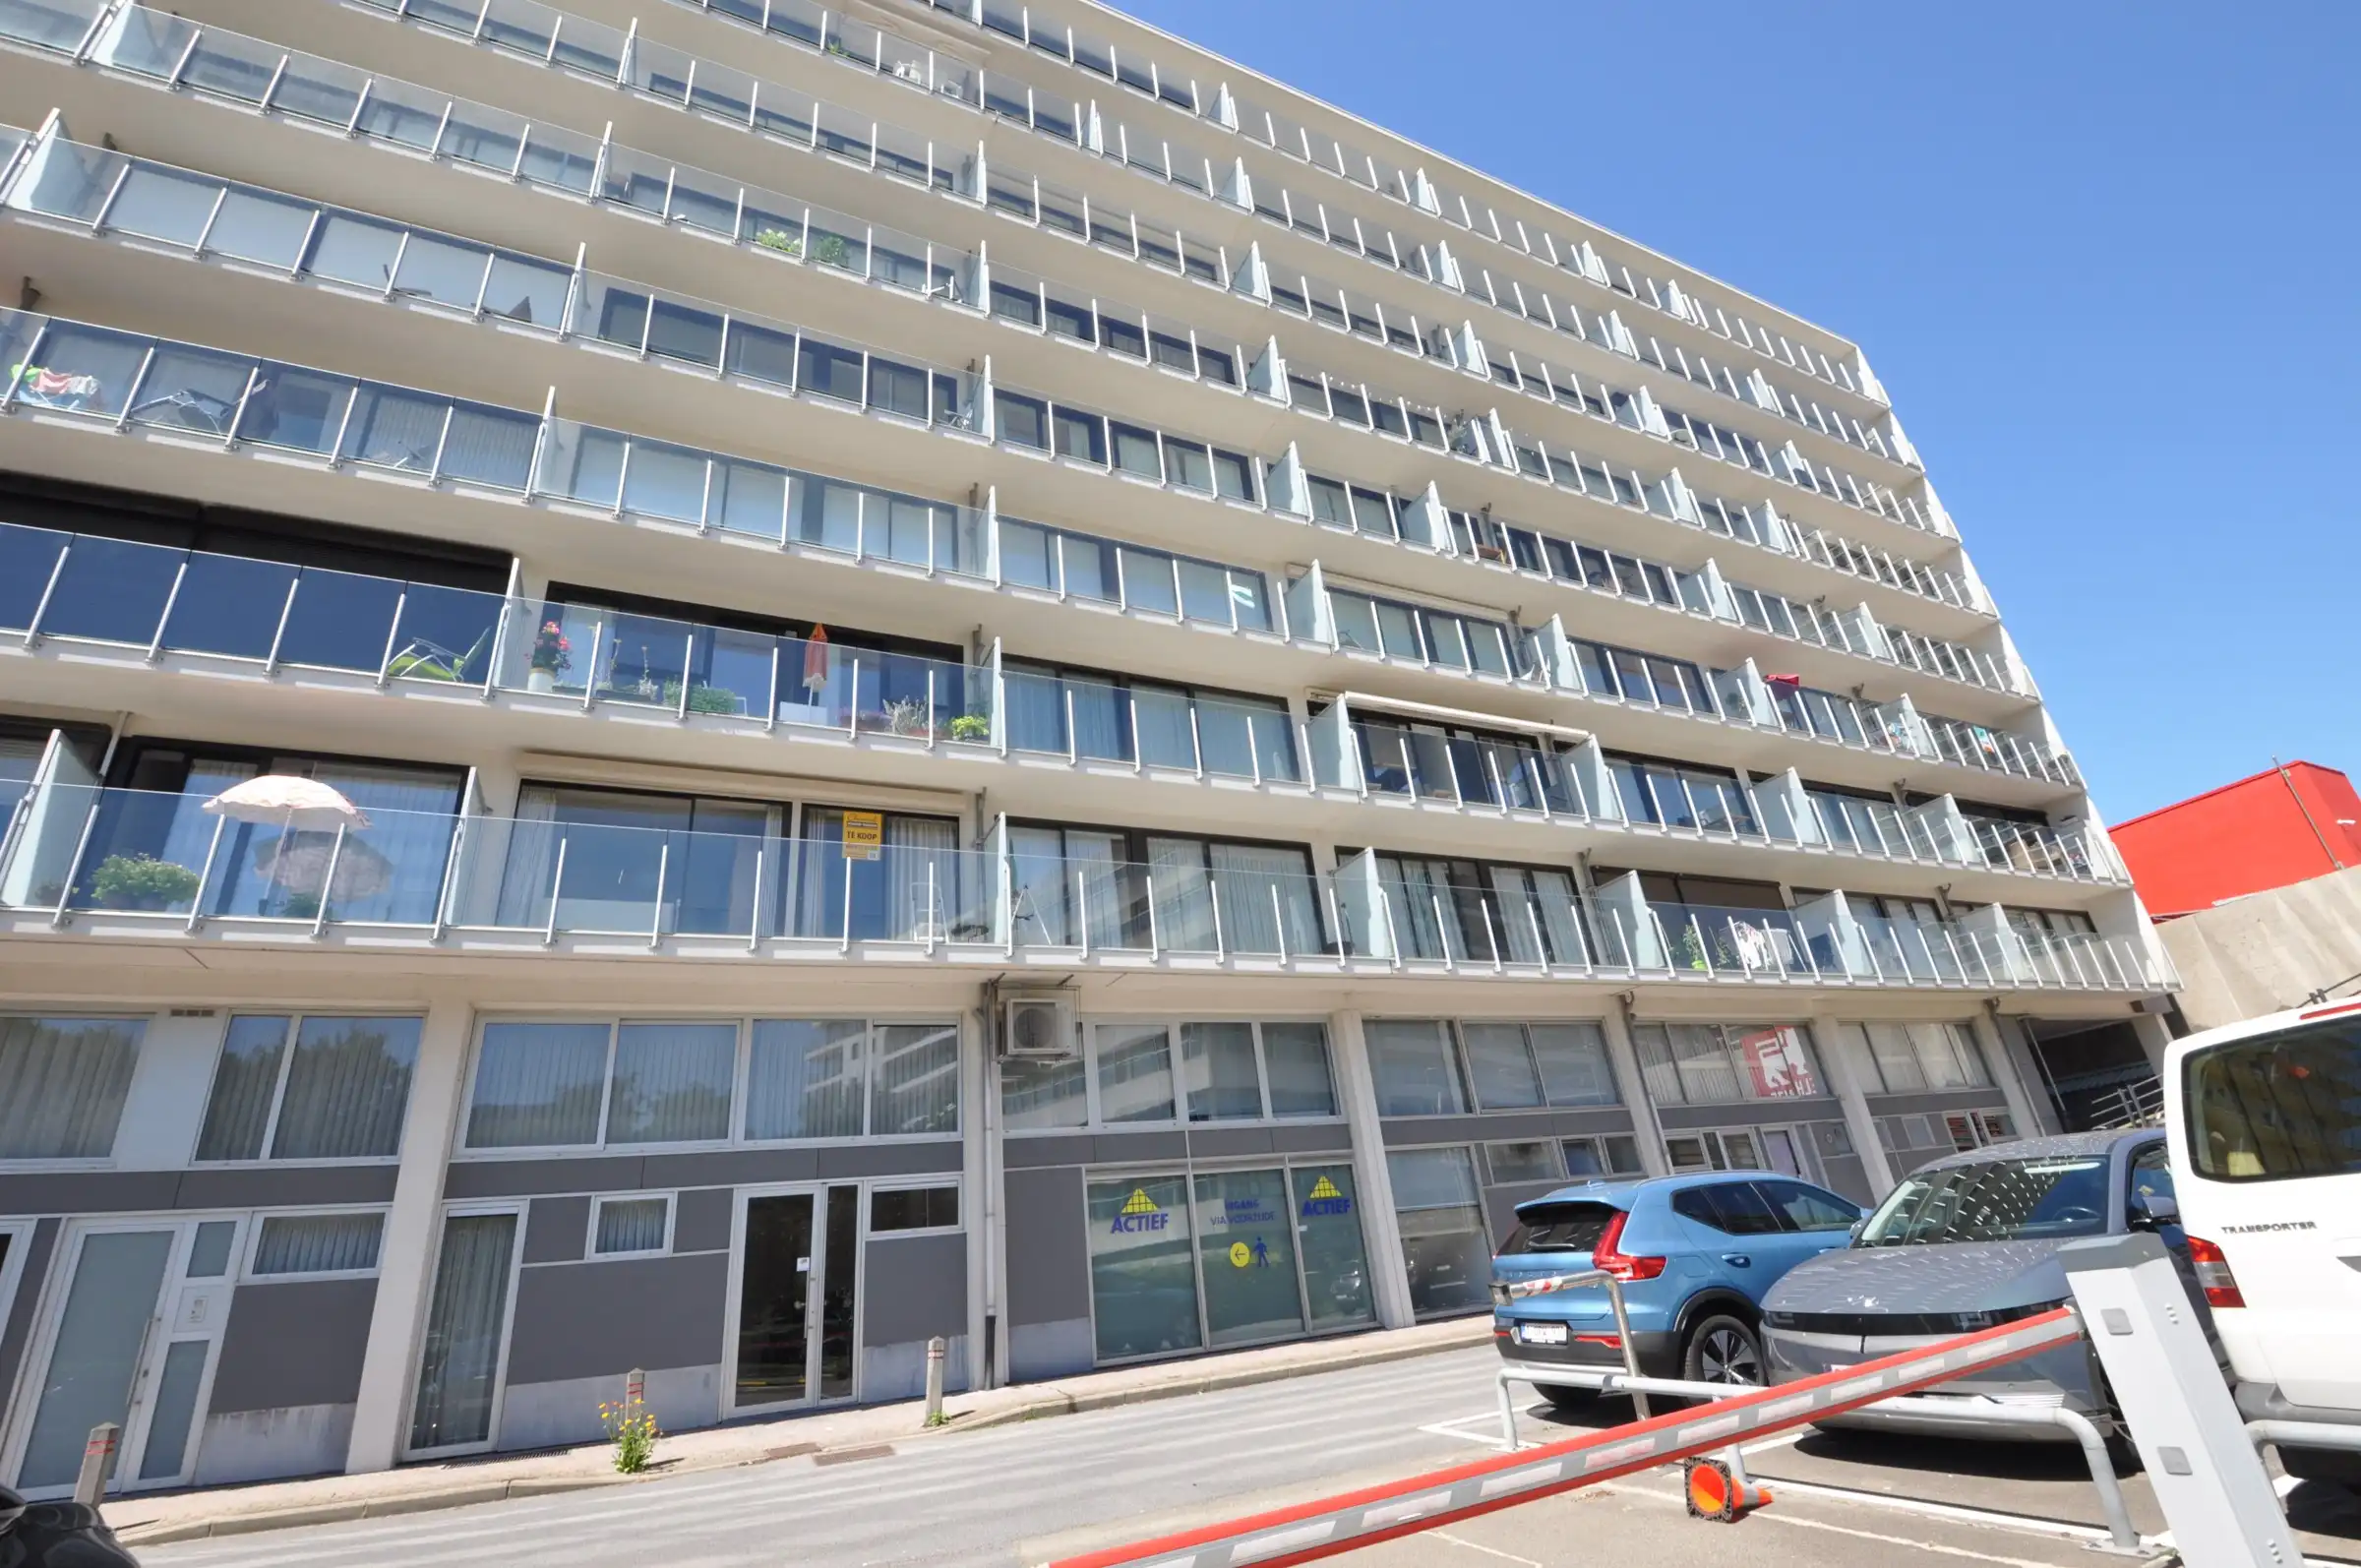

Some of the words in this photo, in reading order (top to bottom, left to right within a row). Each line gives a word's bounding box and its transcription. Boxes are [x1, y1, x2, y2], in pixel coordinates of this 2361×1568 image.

[847, 830, 855, 839] TE
[1302, 1197, 1351, 1217] ACTIEF
[1111, 1213, 1169, 1234] ACTIEF
[1210, 1215, 1227, 1225] VIA
[2220, 1221, 2318, 1235] TRANSPORTER
